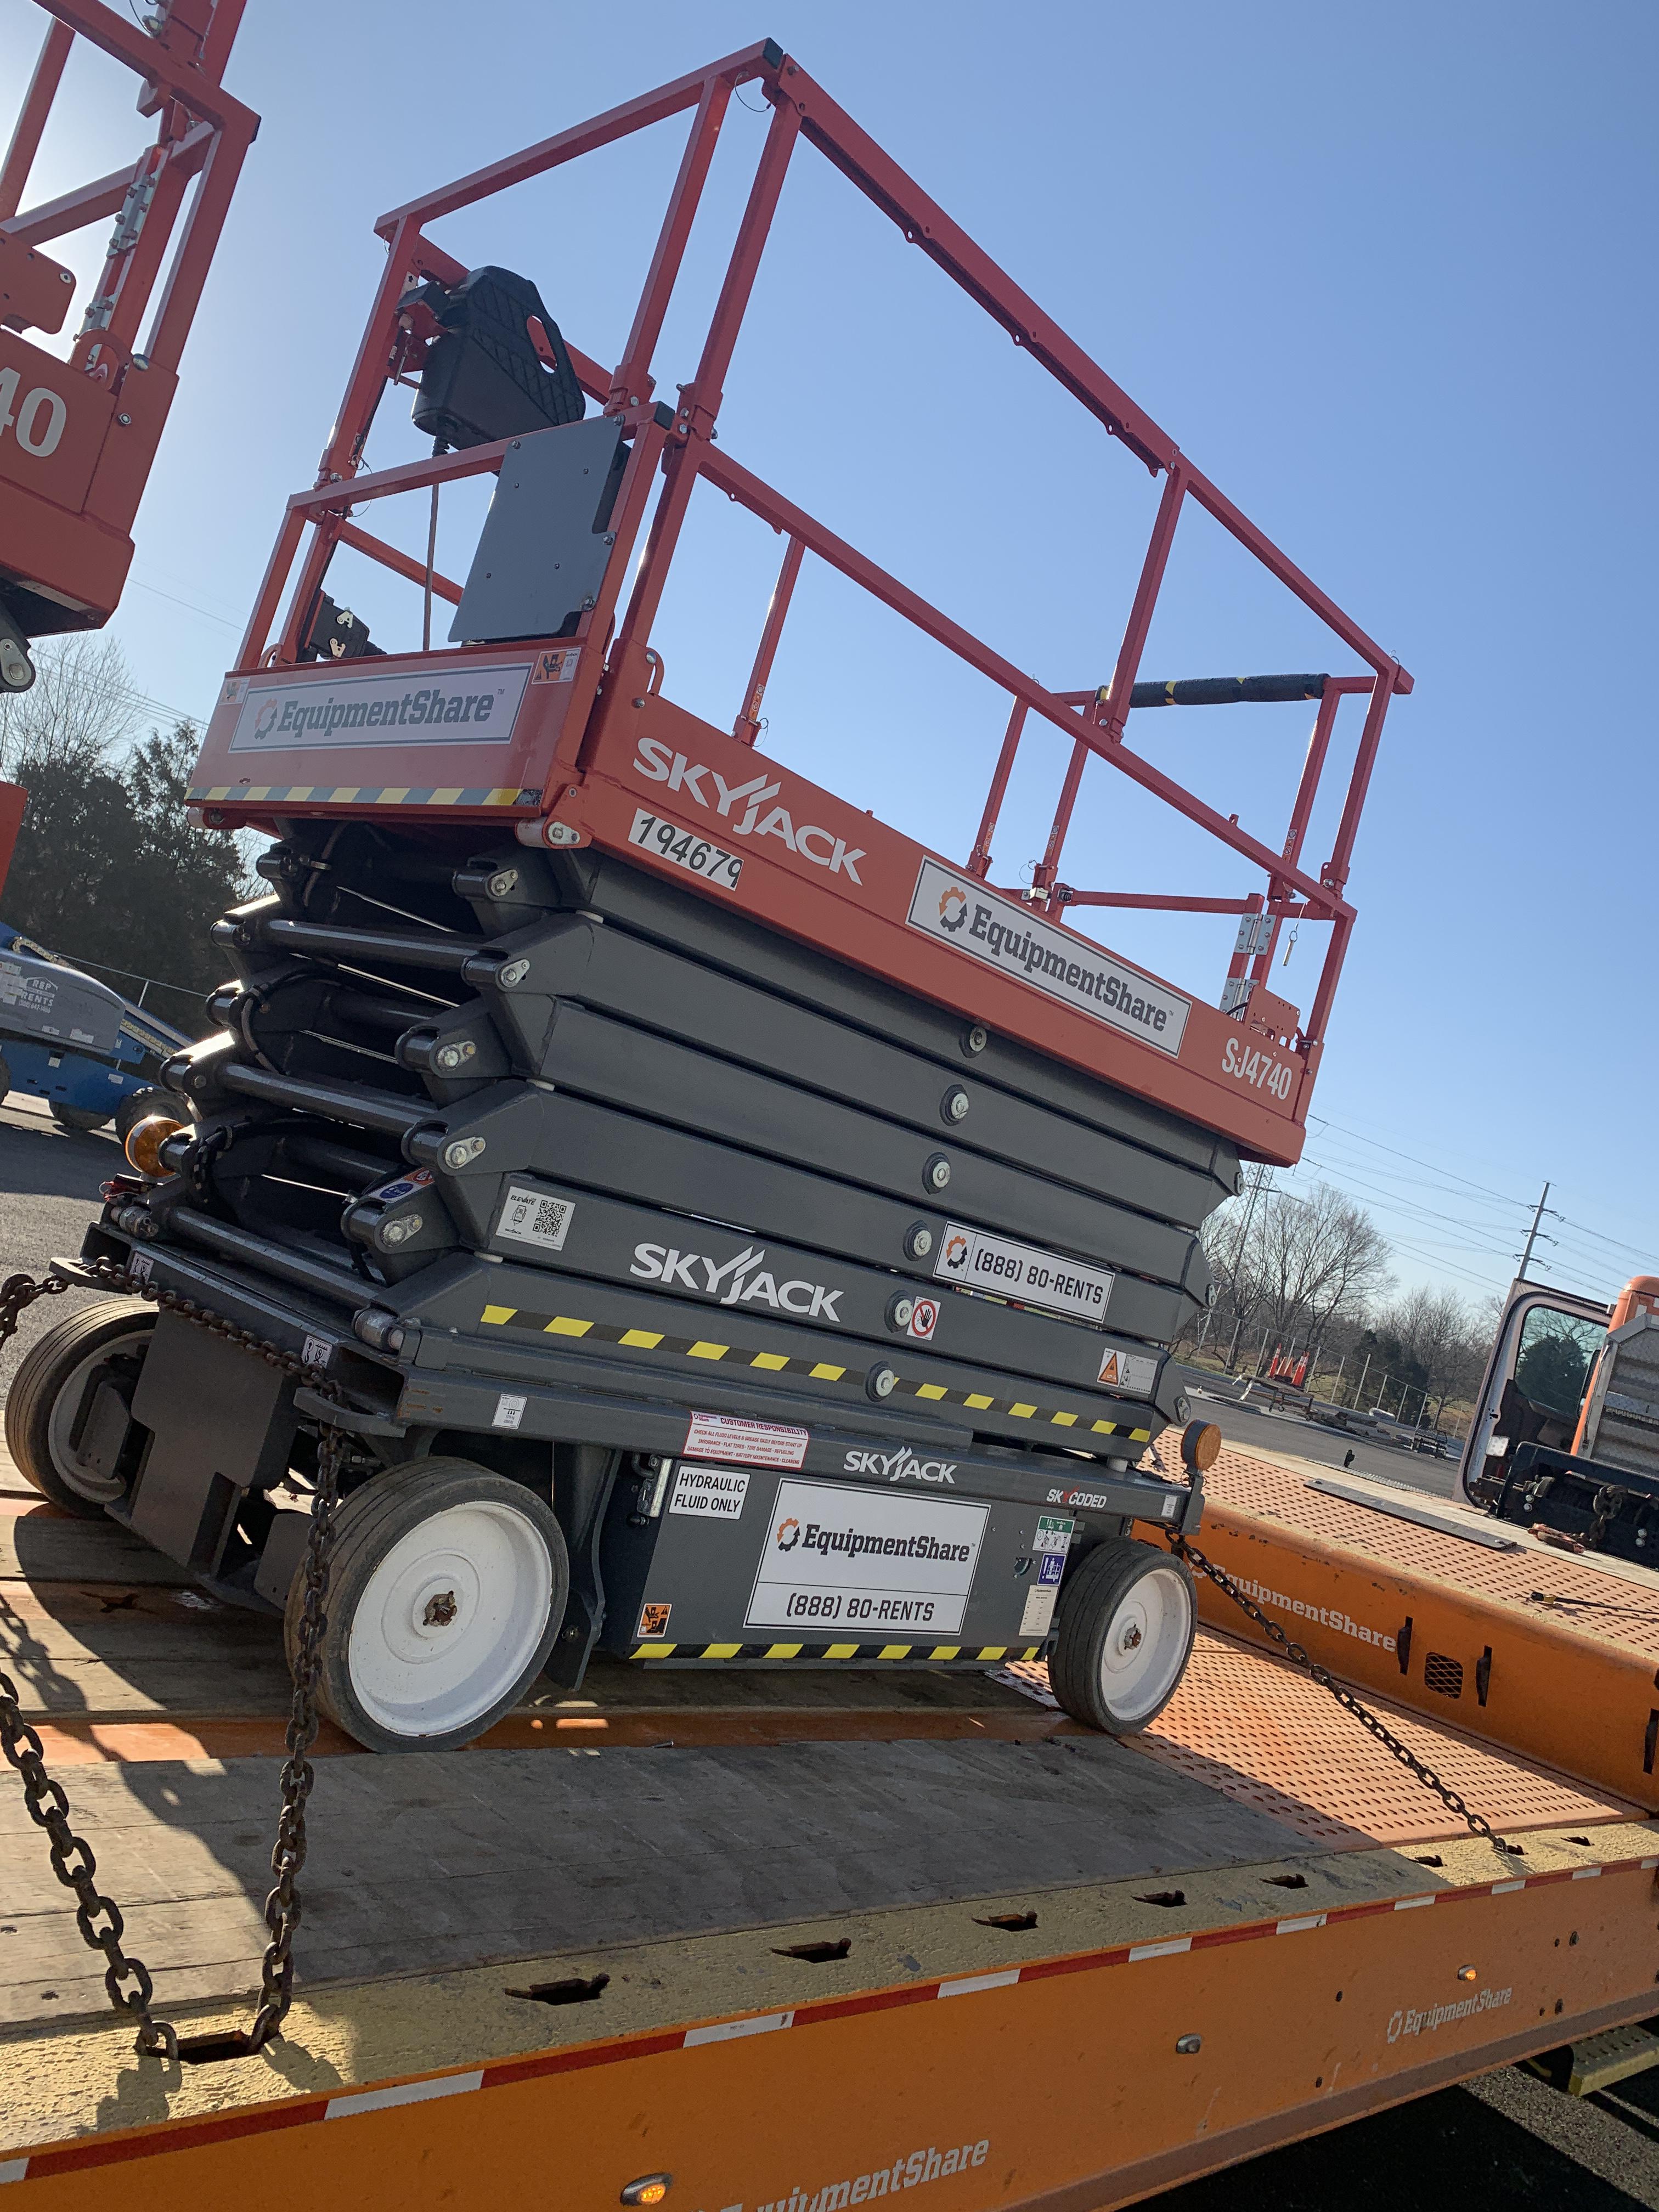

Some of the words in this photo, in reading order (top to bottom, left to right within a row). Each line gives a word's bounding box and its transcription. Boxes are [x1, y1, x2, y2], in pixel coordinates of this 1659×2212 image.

[277, 689, 494, 737] EquipmentShare
[633, 737, 867, 886] SKYJACK
[638, 817, 744, 888] 194679
[969, 904, 1167, 1032] EquipmentShare
[21, 991, 54, 1006] RENTS
[1222, 1037, 1292, 1100] SJ4740
[510, 1194, 536, 1205] ELEVATE
[629, 1243, 844, 1322] SKYJACK
[975, 1248, 1024, 1282] (888)
[1027, 1266, 1104, 1304] 80-RENTS
[720, 1418, 755, 1429] CUSTOMER
[755, 1423, 806, 1436] RESPONSIBILITY
[679, 1473, 746, 1492] HYDRAULIC
[843, 1446, 957, 1483] SKYJACK
[674, 1494, 708, 1509] FLUID
[711, 1498, 741, 1513] ONLY
[1046, 1485, 1107, 1508] SKYCODED
[802, 1523, 969, 1562] EquipmentShare
[786, 1593, 842, 1619] (888)
[847, 1598, 934, 1622] 80-RENTS
[1403, 1988, 1512, 2036] EquipmentShare
